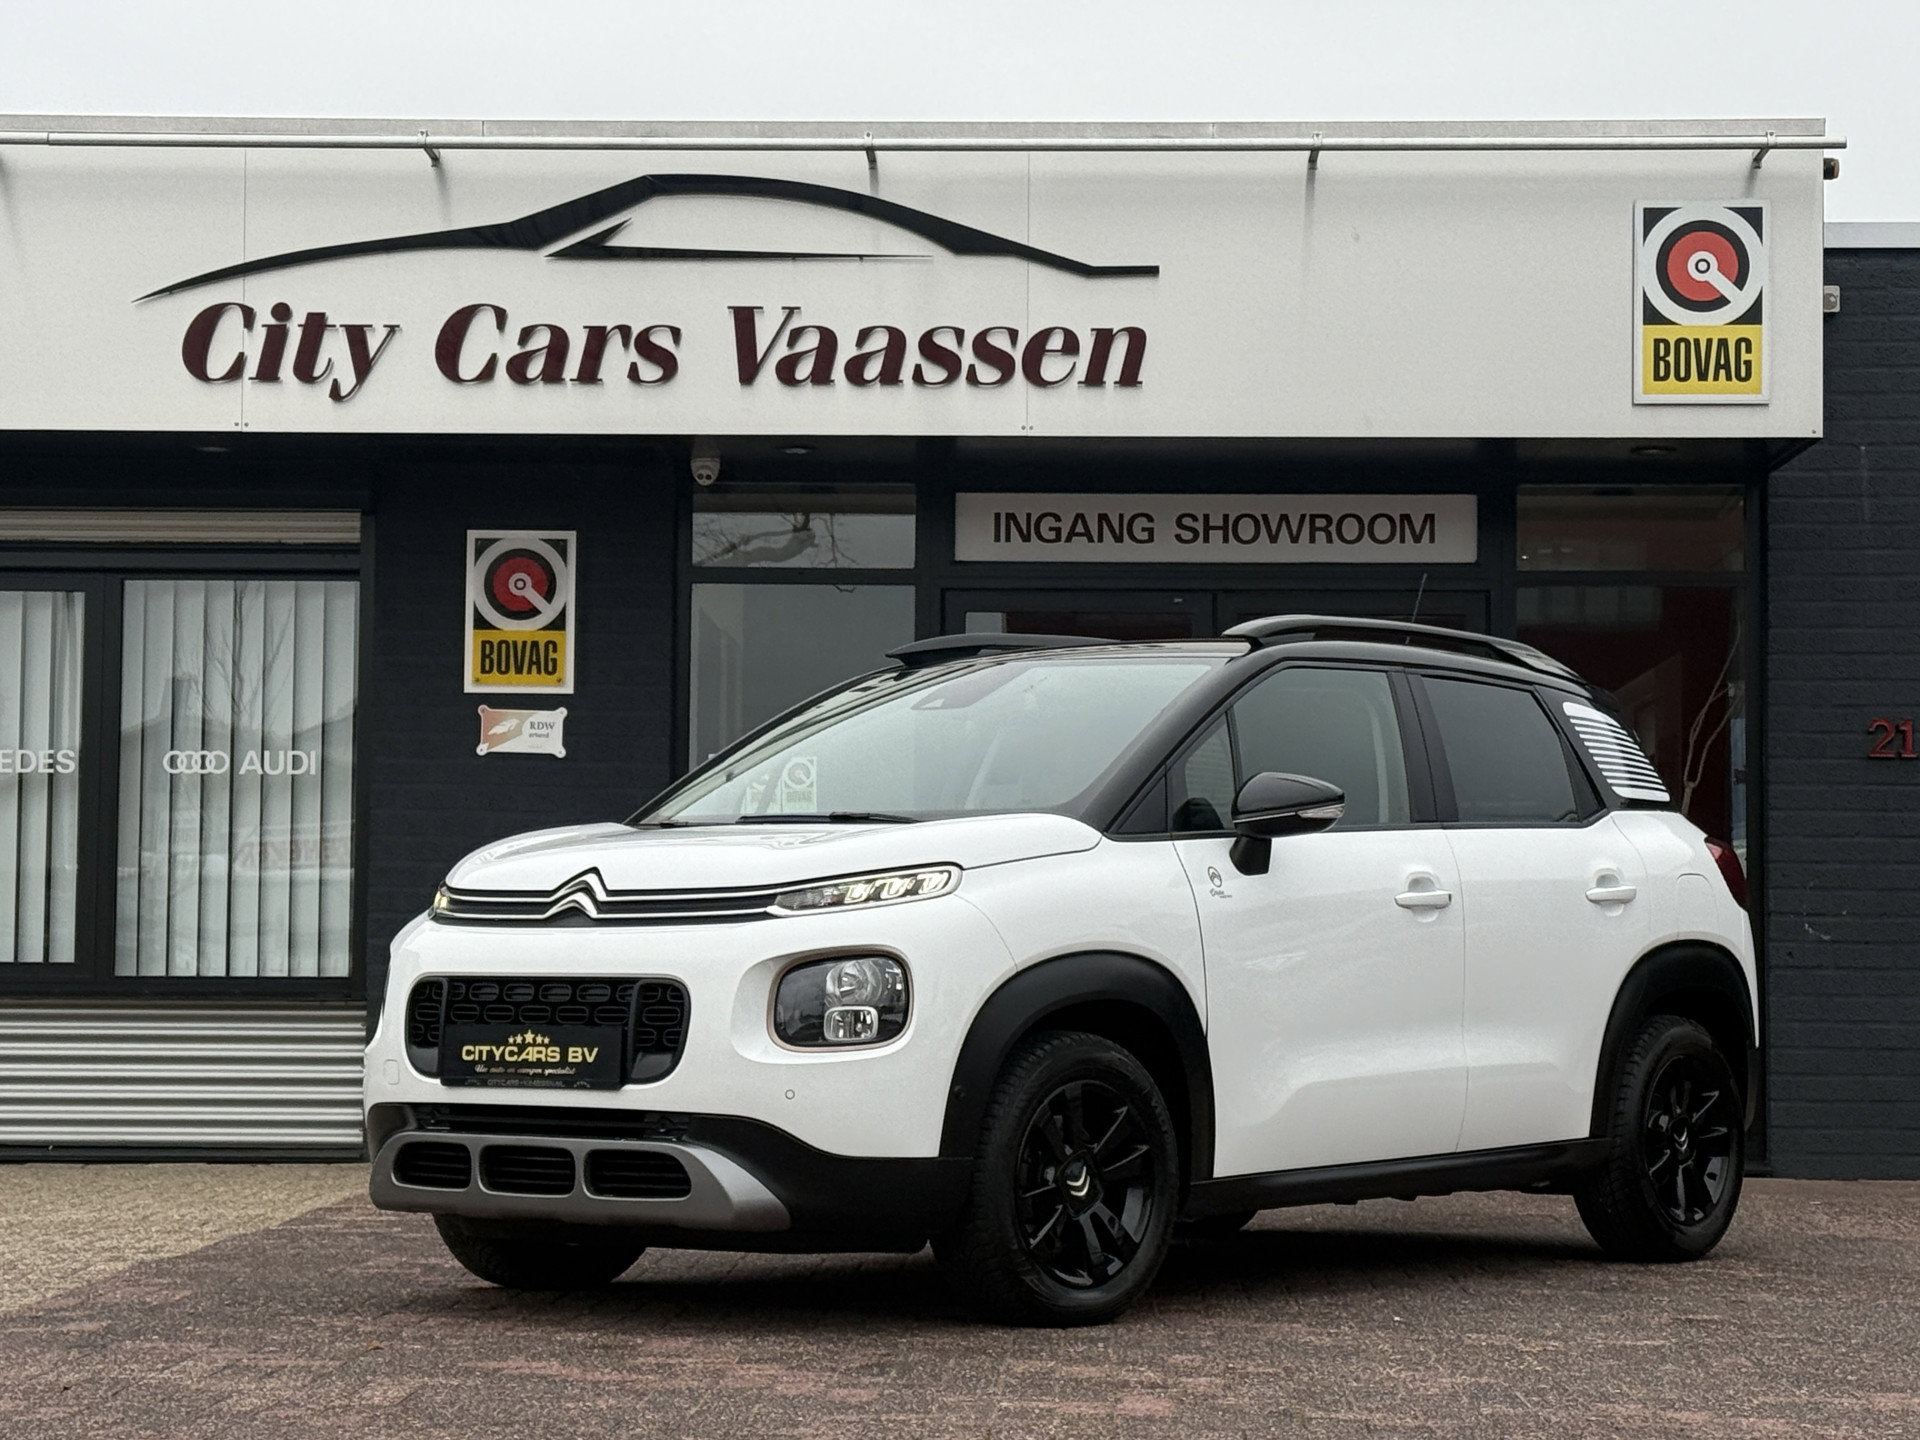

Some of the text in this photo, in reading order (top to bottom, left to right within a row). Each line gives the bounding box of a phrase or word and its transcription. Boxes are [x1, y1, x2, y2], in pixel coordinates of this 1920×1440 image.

[182, 302, 1147, 402] City Cars Vaassen
[1653, 337, 1753, 382] BOVAG
[993, 512, 1436, 545] INGANG SHOWROOM
[480, 640, 557, 675] BOVAG
[529, 721, 556, 731] RDW
[1868, 718, 1918, 758] 21
[239, 750, 317, 775] AUDI
[462, 1045, 599, 1063] CITYCARS BV
